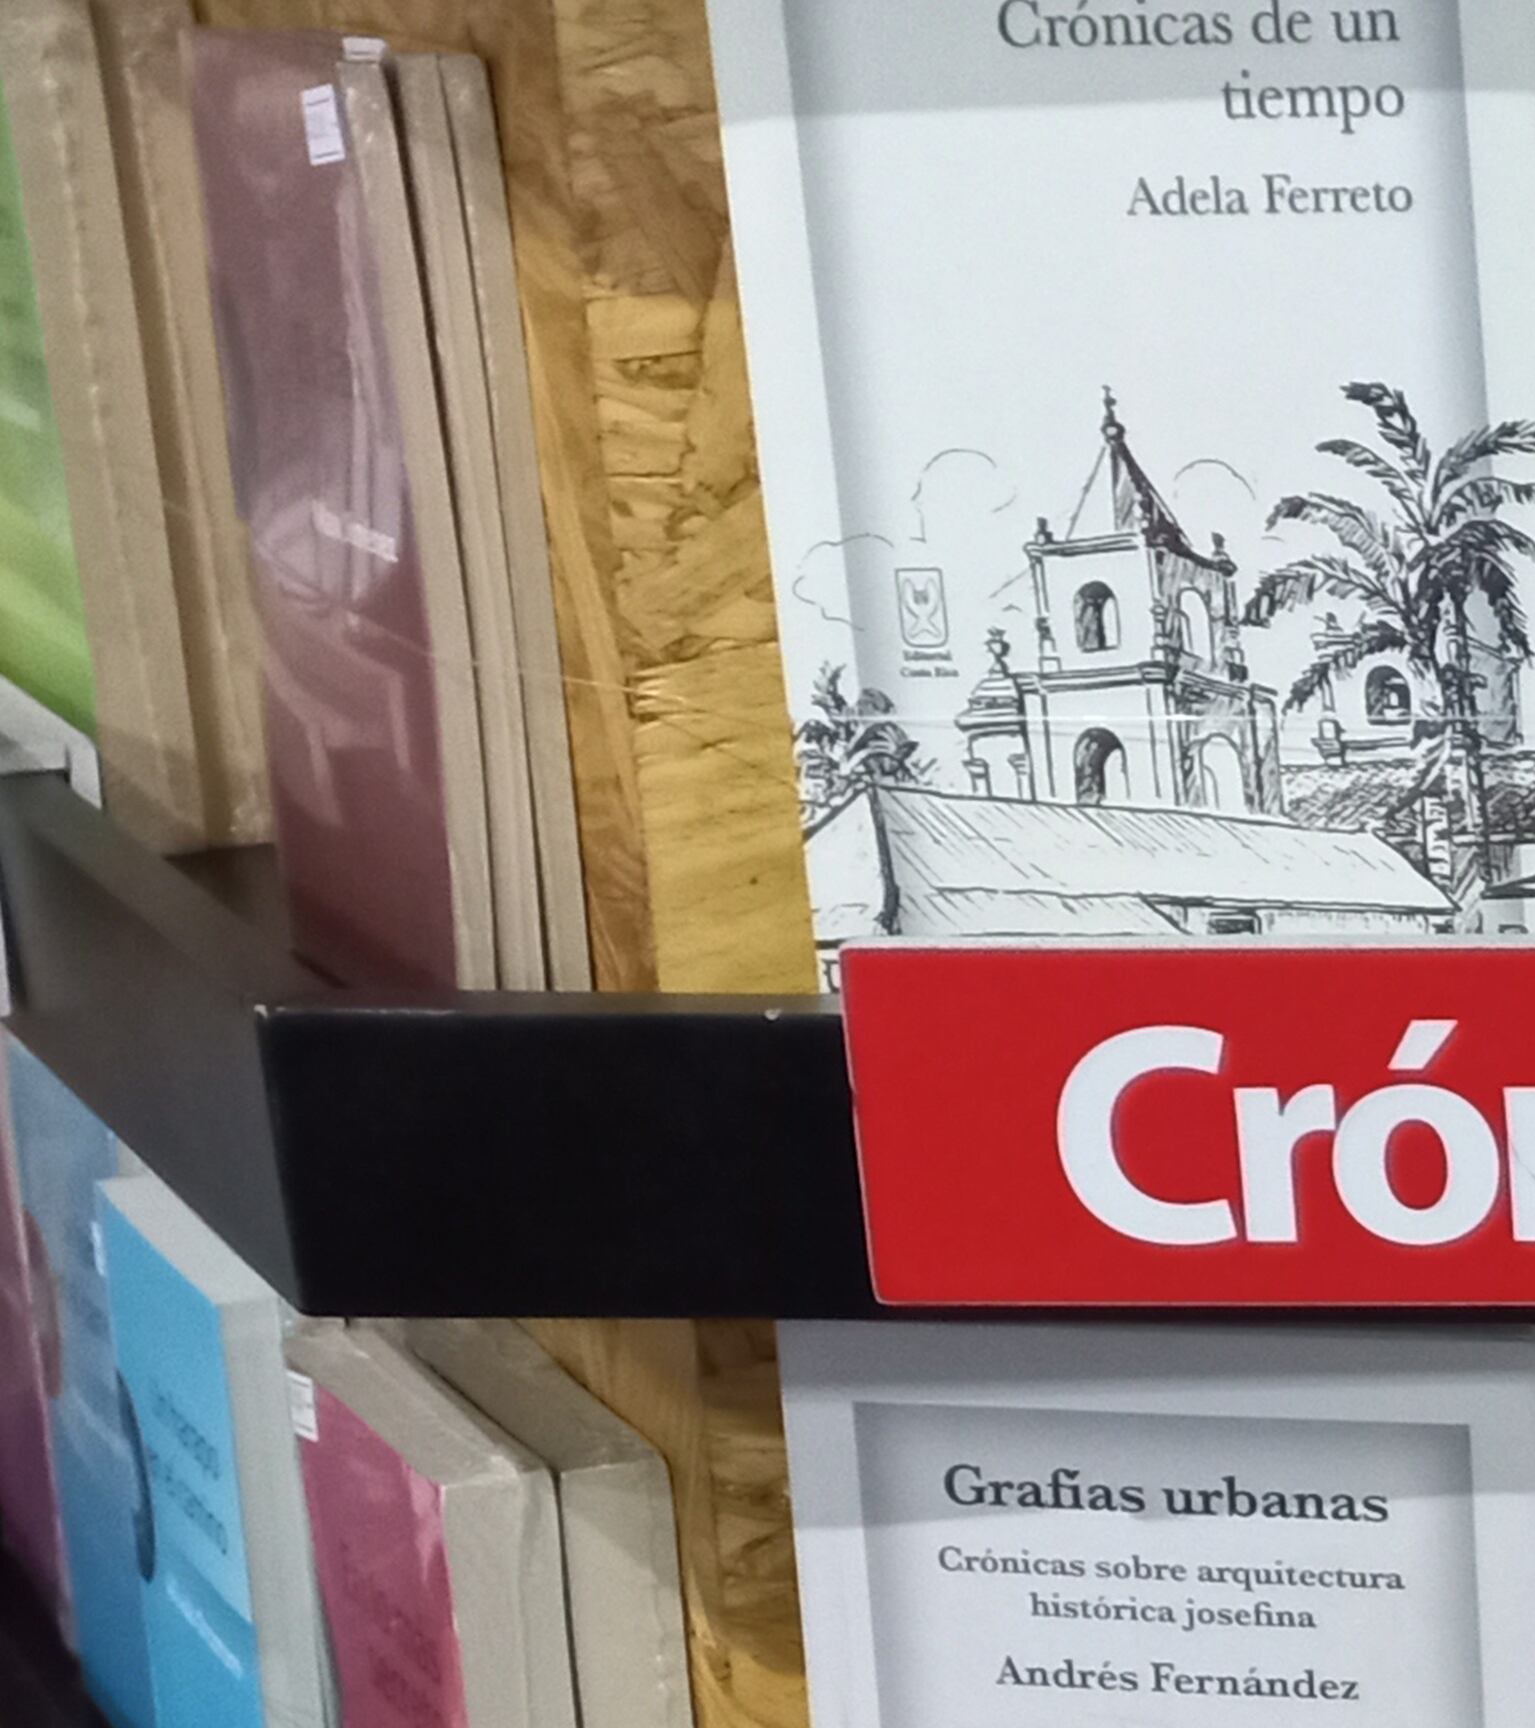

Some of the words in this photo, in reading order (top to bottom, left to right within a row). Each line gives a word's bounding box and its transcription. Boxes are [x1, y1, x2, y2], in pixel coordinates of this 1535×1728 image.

[997, 0, 1233, 49] Crónicas
[1251, 0, 1312, 45] de
[1330, 9, 1400, 43] un
[1221, 69, 1404, 135] tiempo
[1126, 175, 1249, 216] Adela
[1262, 173, 1413, 215] Ferreto
[1162, 1475, 1388, 1523] urbanas
[938, 1545, 1086, 1578] Crónicas
[1094, 1554, 1187, 1582] sobre
[1197, 1560, 1406, 1593] arquitectura
[1029, 1591, 1177, 1624] histórica
[1181, 1598, 1317, 1632] josefina
[996, 1655, 1139, 1692] Andrés
[1150, 1662, 1360, 1700] Fernández
